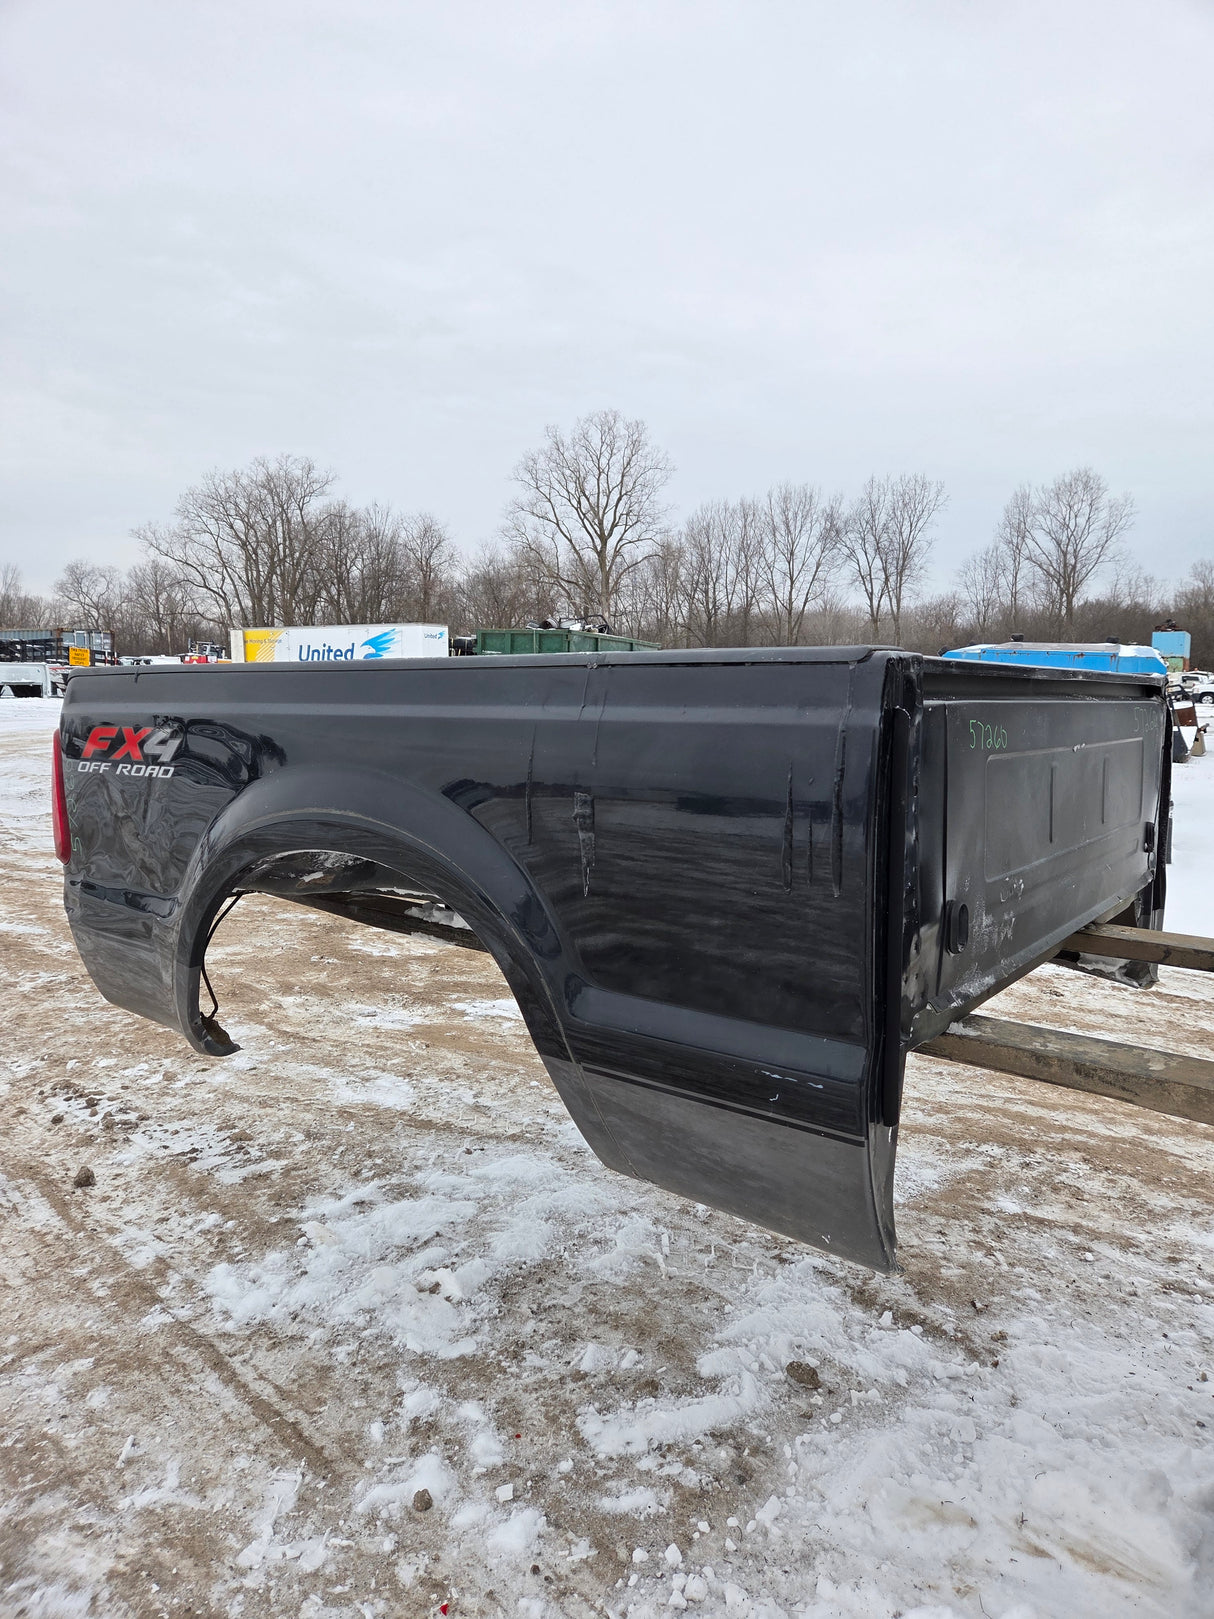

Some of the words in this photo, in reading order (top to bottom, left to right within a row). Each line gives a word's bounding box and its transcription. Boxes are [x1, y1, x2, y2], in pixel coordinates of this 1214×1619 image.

[298, 642, 355, 662] United
[81, 727, 182, 762] FX4
[968, 719, 1008, 750] 57260
[77, 761, 112, 773] OFF
[115, 763, 175, 778] ROAD
